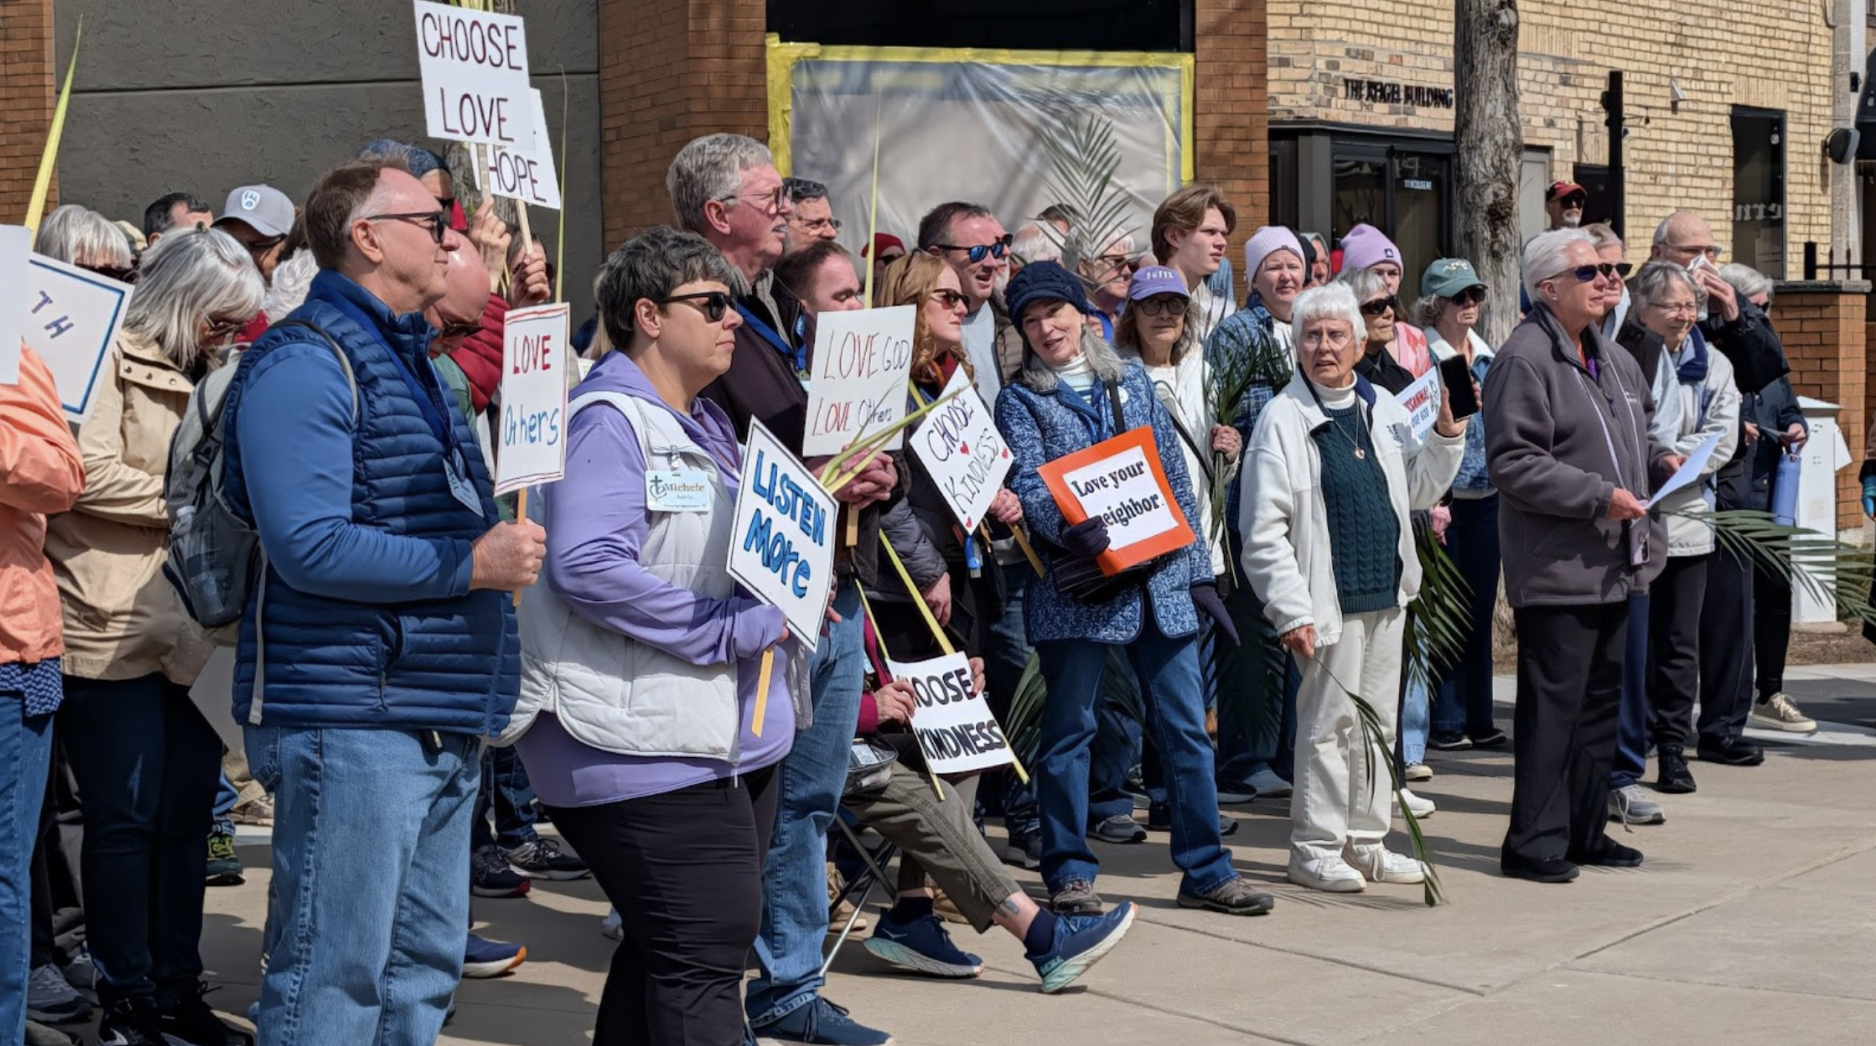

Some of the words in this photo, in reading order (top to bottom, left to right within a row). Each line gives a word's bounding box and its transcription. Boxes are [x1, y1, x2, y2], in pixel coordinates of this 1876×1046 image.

[422, 12, 522, 71] CHOOSE
[1343, 78, 1363, 100] THE
[1403, 84, 1453, 109] BUILDING
[440, 87, 514, 142] LOVE
[488, 144, 547, 203] HOPE
[513, 334, 552, 374] LOVE
[824, 329, 880, 379] LOVE
[882, 335, 911, 372] GOD
[812, 397, 853, 436] LOVE
[927, 394, 974, 462] CHOOSE
[665, 483, 705, 492] Michele
[944, 427, 1000, 515] KINDNESS
[1071, 475, 1109, 498] Love
[1107, 460, 1145, 489] your
[753, 448, 826, 547] LISTEN
[1102, 493, 1165, 528] eighbor.
[897, 667, 978, 708] OOSE
[914, 719, 1007, 760] KINDNESS
